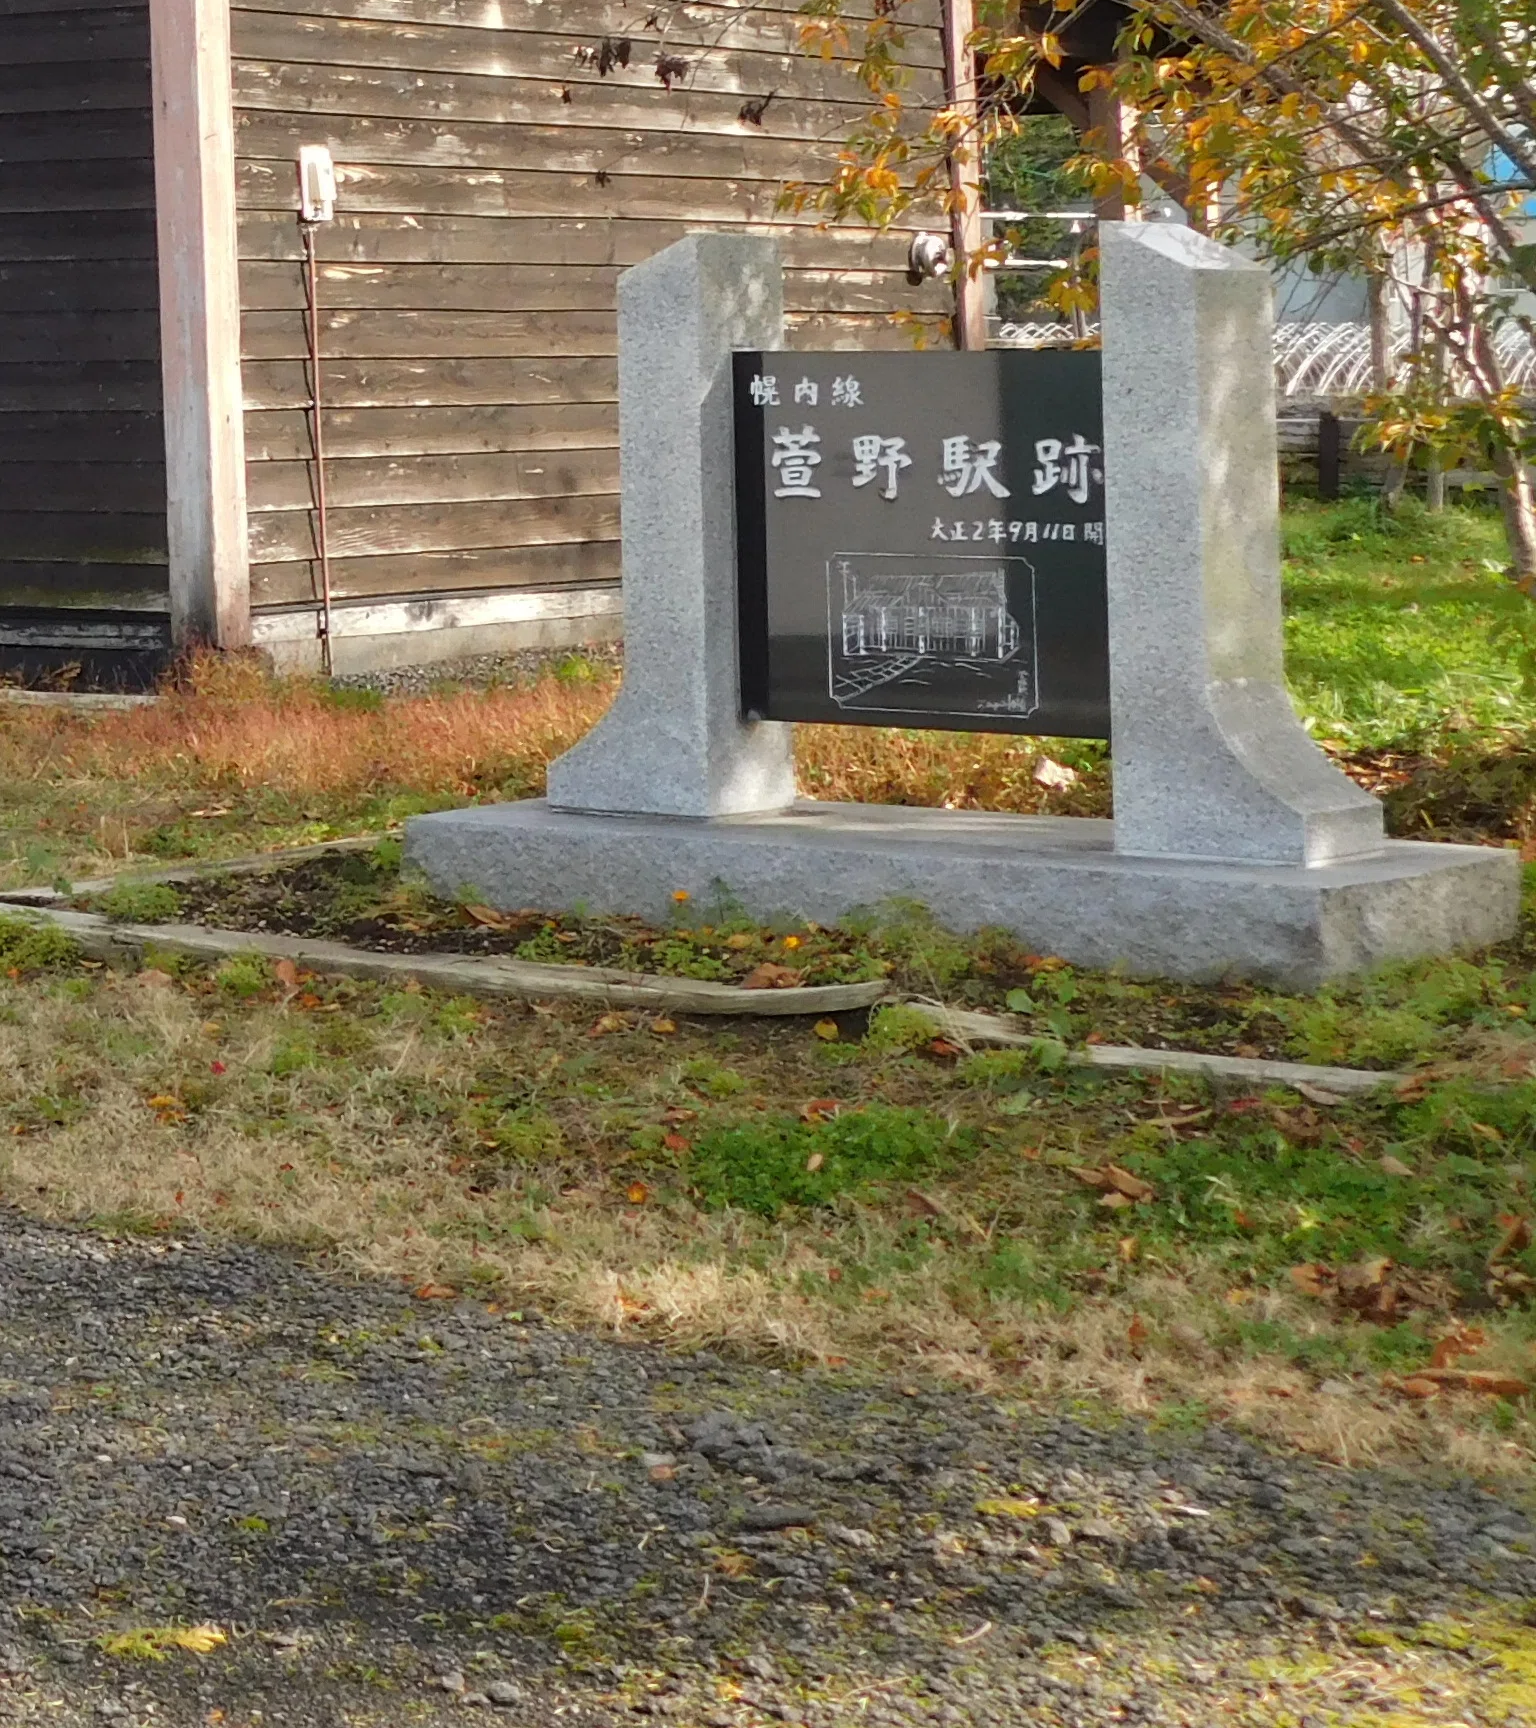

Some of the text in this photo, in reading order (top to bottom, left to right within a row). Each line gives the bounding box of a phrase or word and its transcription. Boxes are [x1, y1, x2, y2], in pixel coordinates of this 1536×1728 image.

[750, 374, 864, 408] 幌内線
[771, 424, 1104, 505] 萱野駅跡
